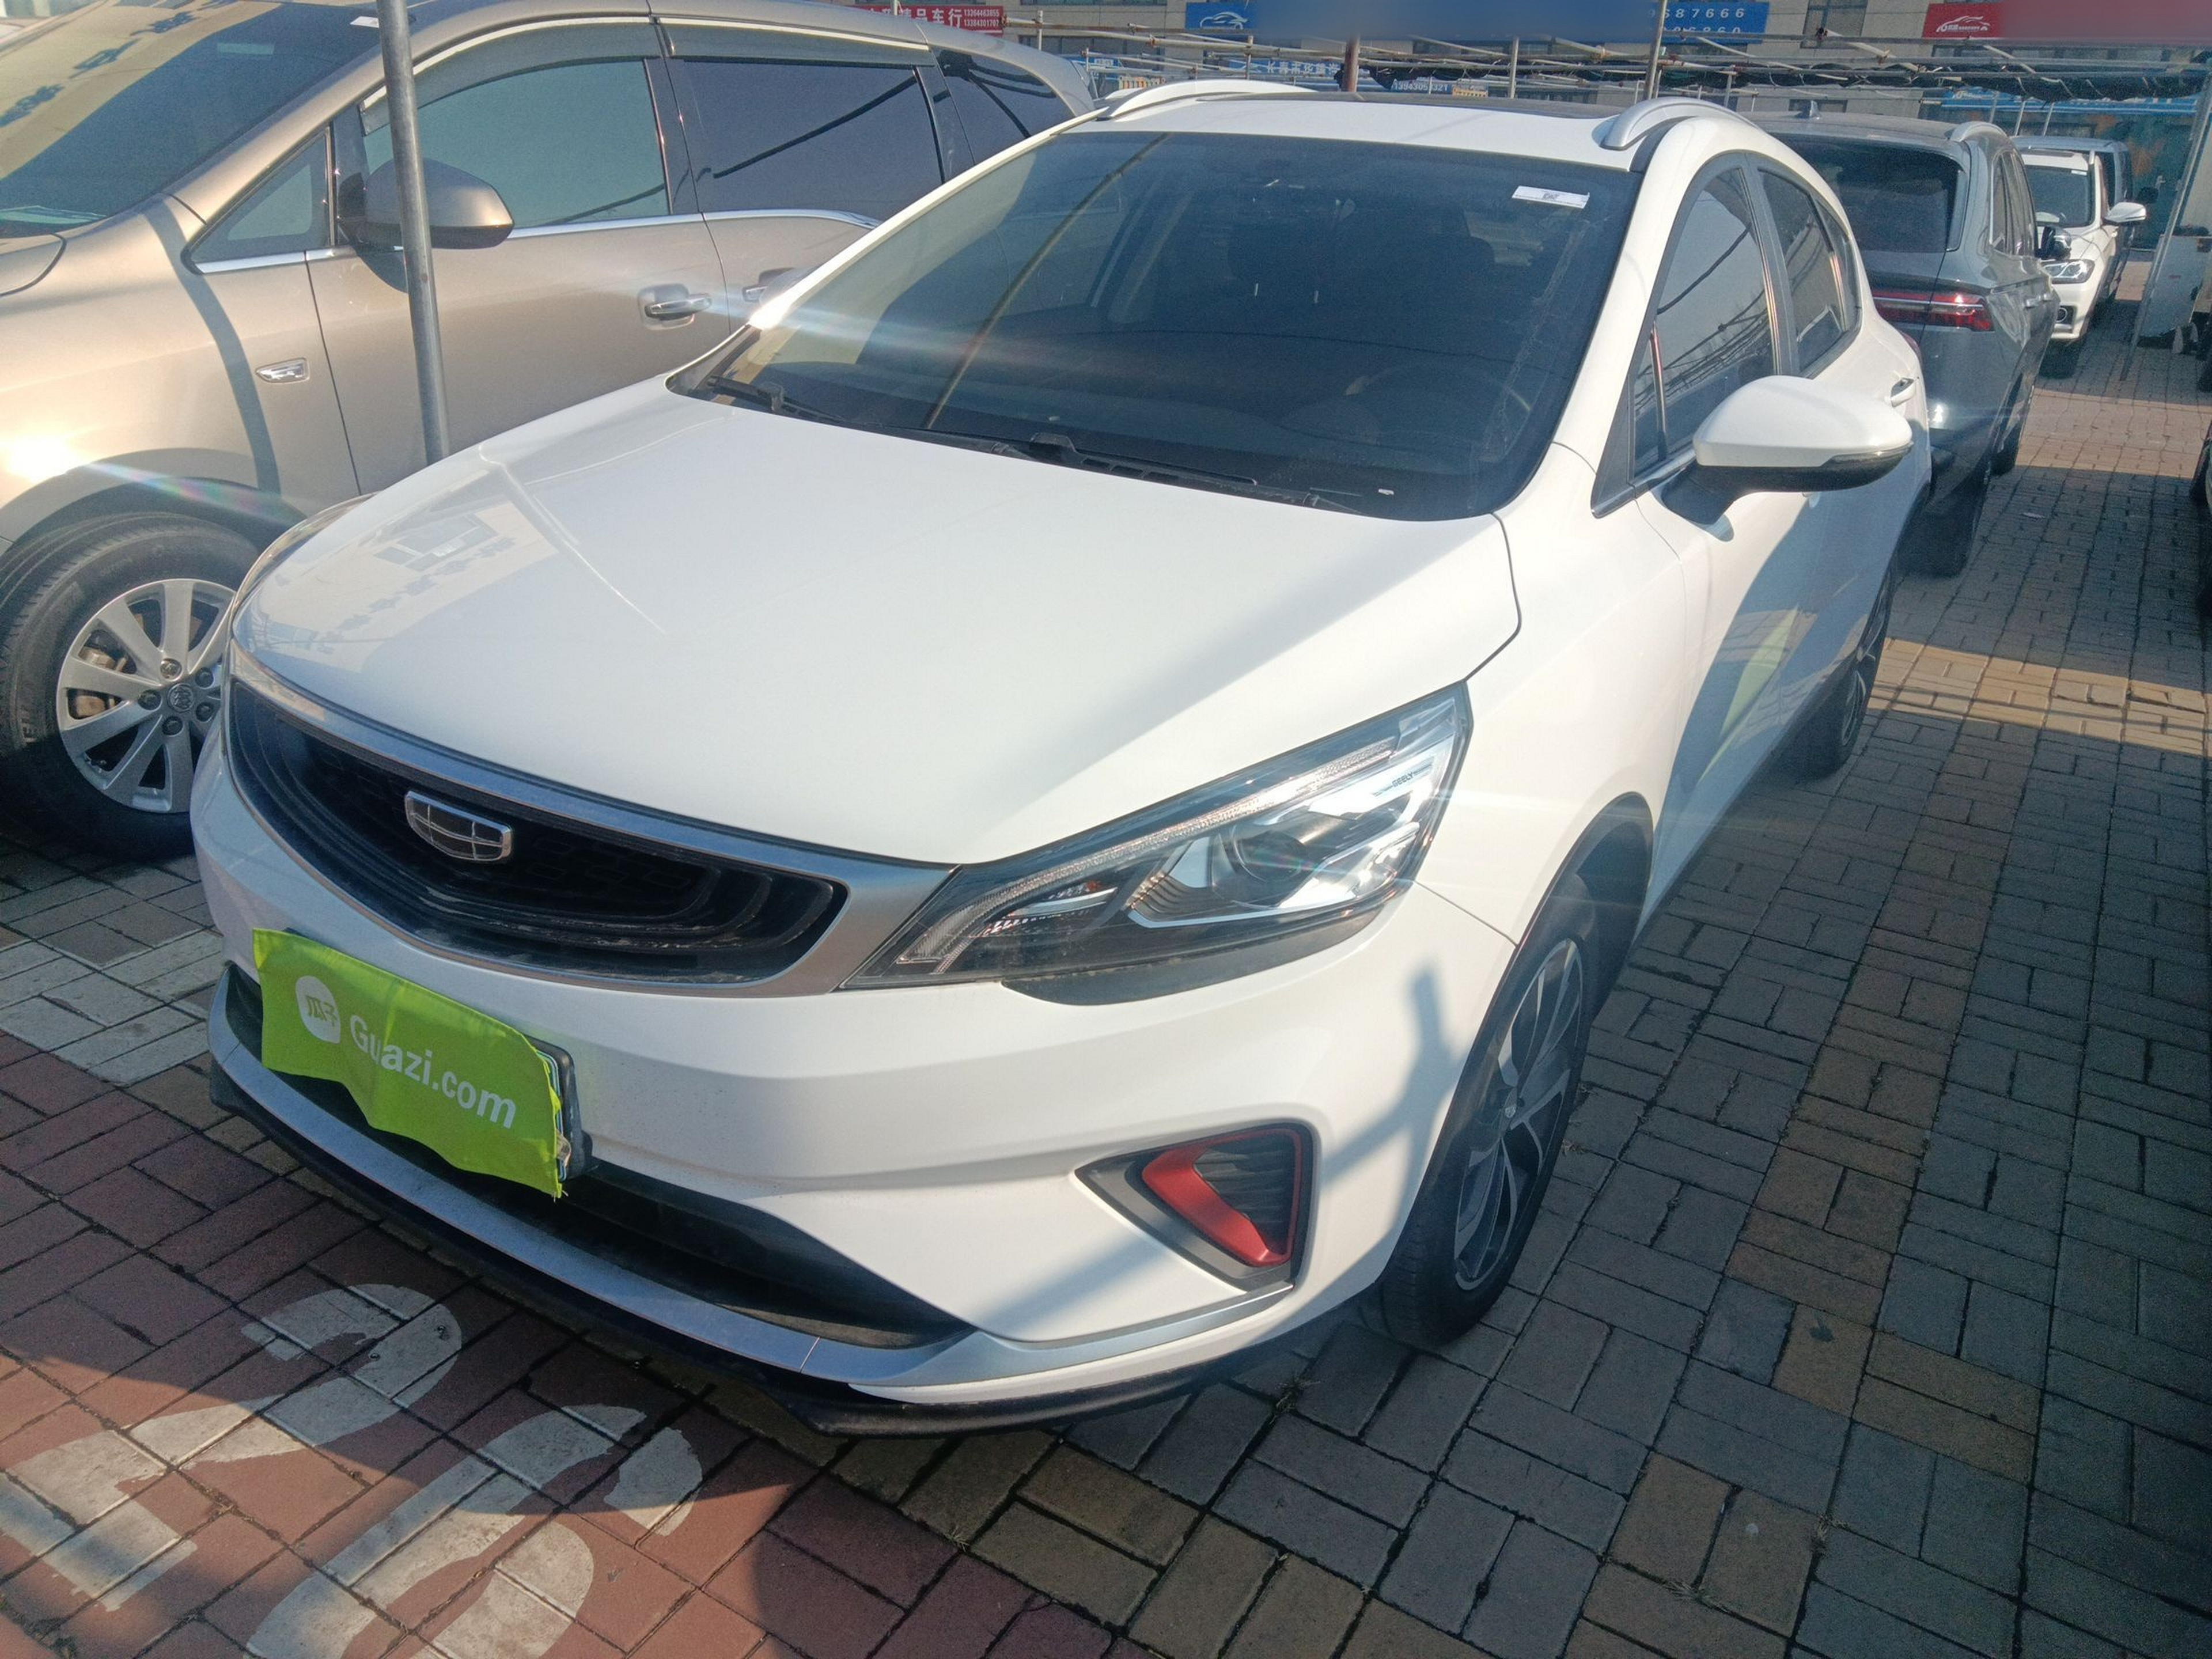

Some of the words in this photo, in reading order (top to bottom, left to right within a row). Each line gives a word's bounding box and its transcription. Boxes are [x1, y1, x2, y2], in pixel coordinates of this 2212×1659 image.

[1392, 771, 1414, 787] GEELY
[306, 996, 336, 1025] 瓜子
[349, 1014, 517, 1130] Guazi.com
